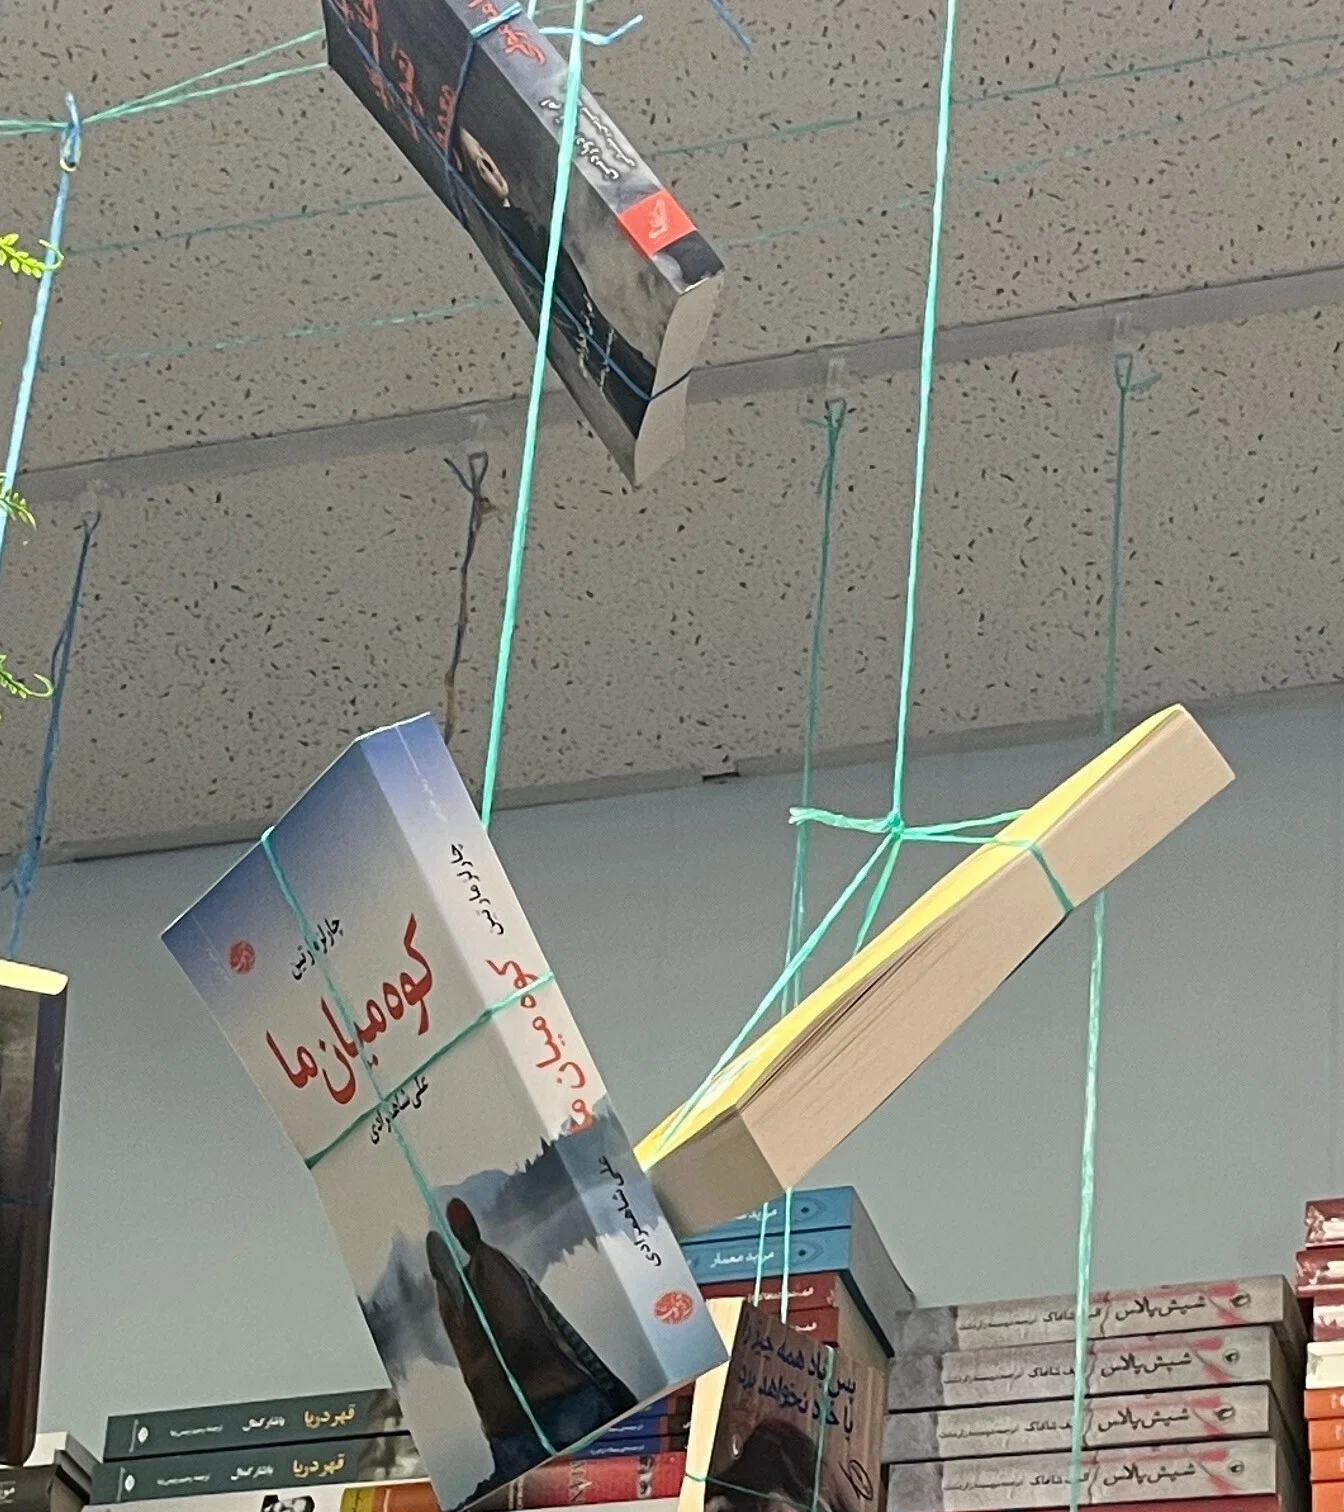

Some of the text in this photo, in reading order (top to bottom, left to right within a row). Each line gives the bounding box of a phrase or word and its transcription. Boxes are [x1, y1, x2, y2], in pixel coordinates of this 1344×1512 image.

[266, 913, 434, 1105] کوه میان ما
[532, 1015, 586, 1089] میان
[565, 1097, 593, 1134] ما
[1114, 1293, 1206, 1321] شپش پالاس
[1100, 1351, 1193, 1379] شپش پالاس
[303, 1403, 356, 1429] قهر دریا
[1097, 1407, 1191, 1433] شپش پالاس
[292, 1454, 346, 1478] قهر دریا
[1102, 1462, 1196, 1488] شپش پالاس
